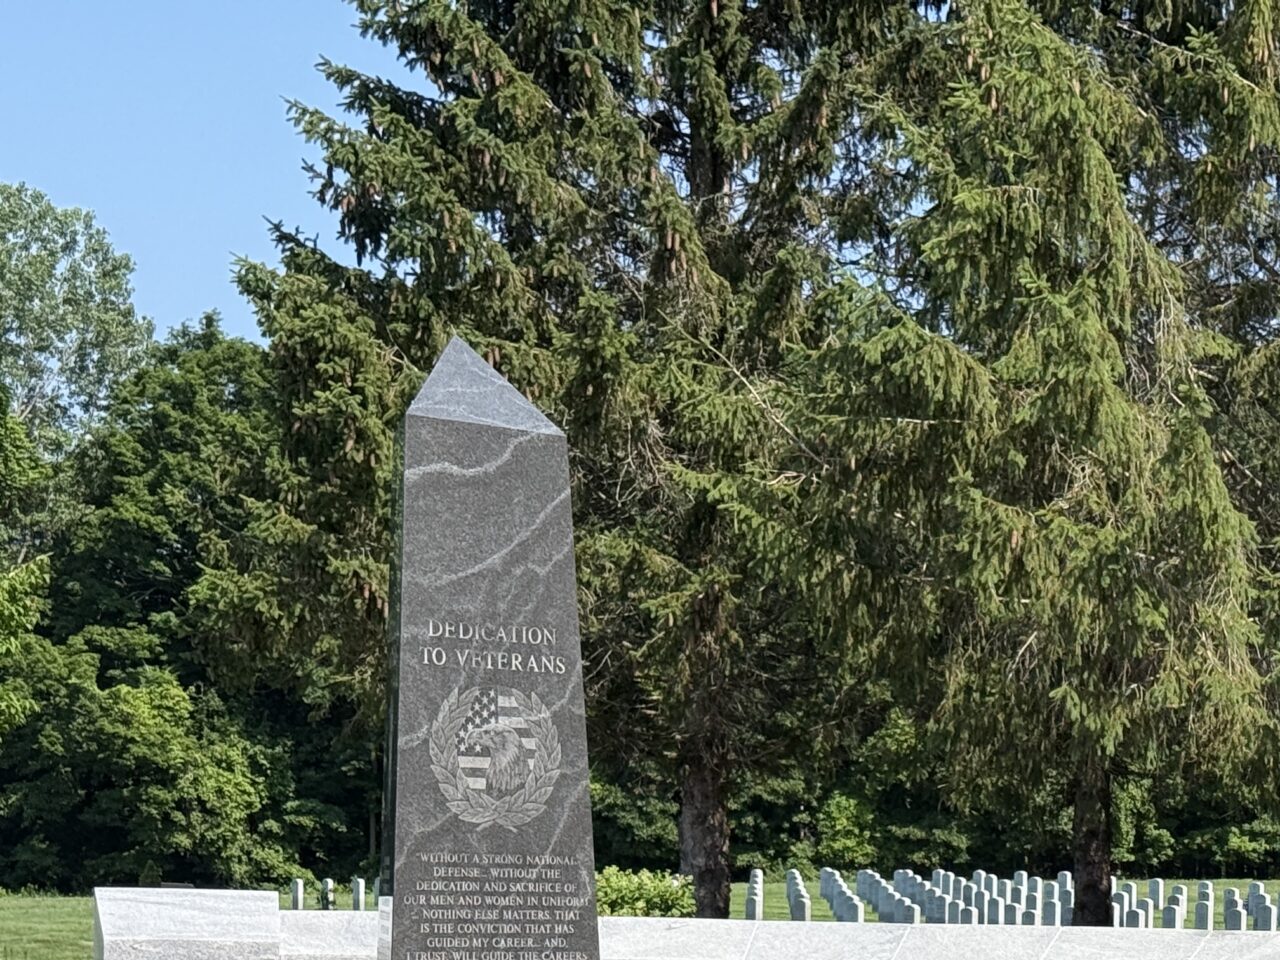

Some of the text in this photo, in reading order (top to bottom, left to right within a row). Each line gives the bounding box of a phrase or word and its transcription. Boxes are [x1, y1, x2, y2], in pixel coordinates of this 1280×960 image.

[428, 620, 557, 645] DEDICATION
[420, 647, 566, 674] TO VETERANS
[472, 855, 479, 863] A
[483, 854, 522, 864] STRONG
[526, 855, 577, 865] NATIONAL
[491, 868, 537, 878] WITHOUT
[541, 869, 560, 878] THE
[416, 881, 577, 892] DEDICATION AND SACRIFICE OF
[404, 896, 589, 906] OUR MEN AND WOMEN IN UNIFORM
[423, 910, 471, 919] NOTHING
[475, 910, 499, 919] ELSE
[554, 910, 580, 920] THAT
[421, 924, 574, 933] IS THE CONVICTION THAT HAS
[427, 938, 469, 947] GUIDED
[473, 938, 488, 947] MY
[452, 953, 479, 960] WILL
[481, 952, 515, 960] GUIDE
[518, 952, 538, 960] THE
[542, 952, 587, 960] CAREERS
